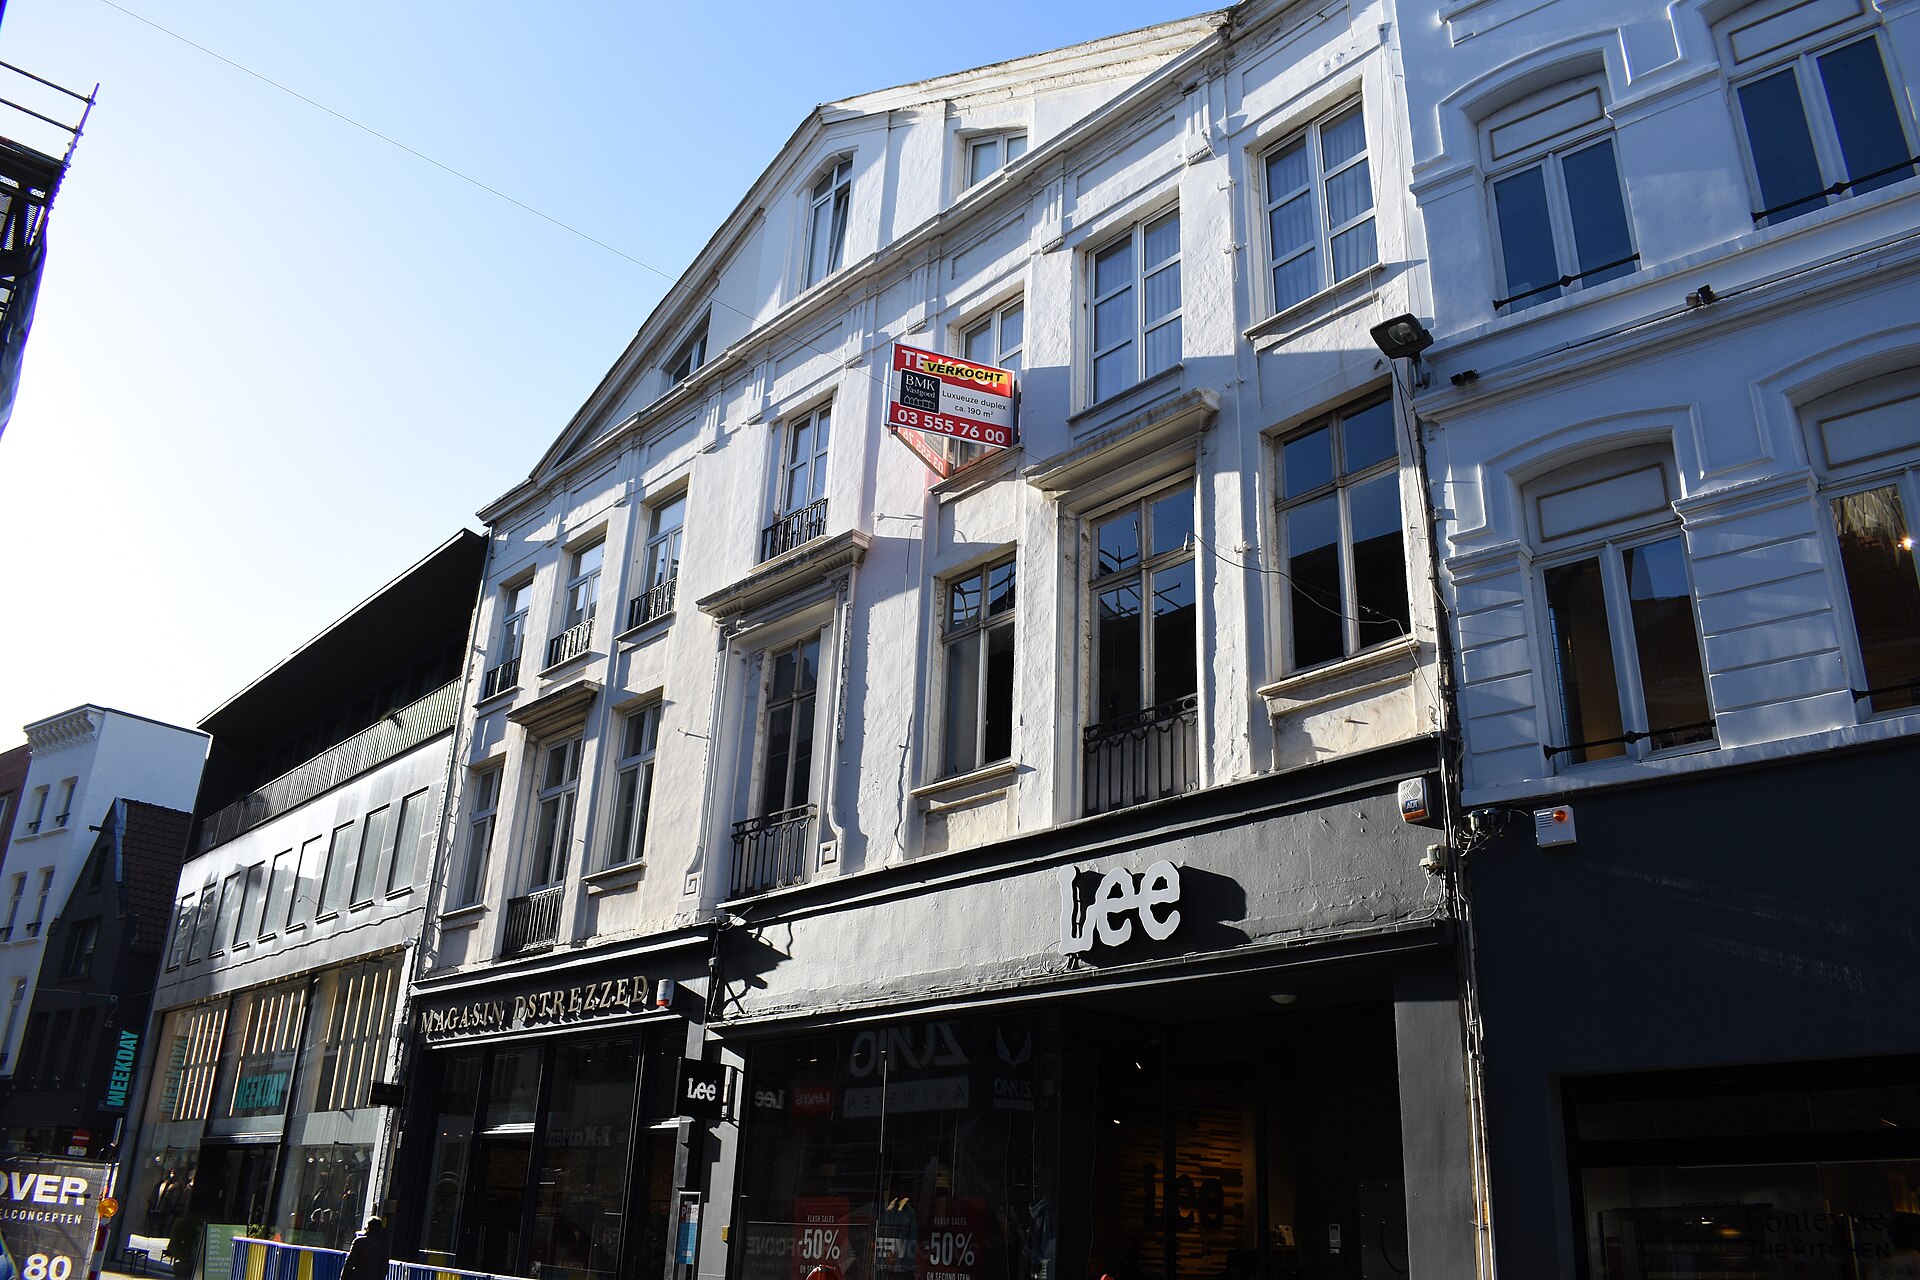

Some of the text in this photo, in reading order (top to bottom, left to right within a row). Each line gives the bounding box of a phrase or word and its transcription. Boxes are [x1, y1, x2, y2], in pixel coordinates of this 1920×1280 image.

[901, 349, 929, 369] TE
[905, 374, 935, 391] BMK
[928, 362, 1003, 382] VERKOCHT
[905, 385, 936, 399] Vastgoed
[942, 390, 1007, 411] Luxueuze duplex
[954, 405, 966, 413] ca.
[967, 406, 981, 416] 190
[897, 409, 1005, 444] 03 555 76 00
[1056, 860, 1181, 956] Lee
[419, 975, 650, 1035] MAGASIN DSTREZZED
[106, 1029, 140, 1108] WEEKDAY
[234, 1072, 287, 1110] WEEKDAY
[687, 1077, 717, 1102] Lee
[807, 1214, 835, 1223] FLASH SALES
[934, 1217, 967, 1226] FLASH SALES
[798, 1228, 841, 1260] -50%
[924, 1231, 975, 1266] -50%
[1746, 1244, 1786, 1260] THE
[23, 1253, 73, 1280] 80
[926, 1271, 971, 1280] ON SECOND ITEM
